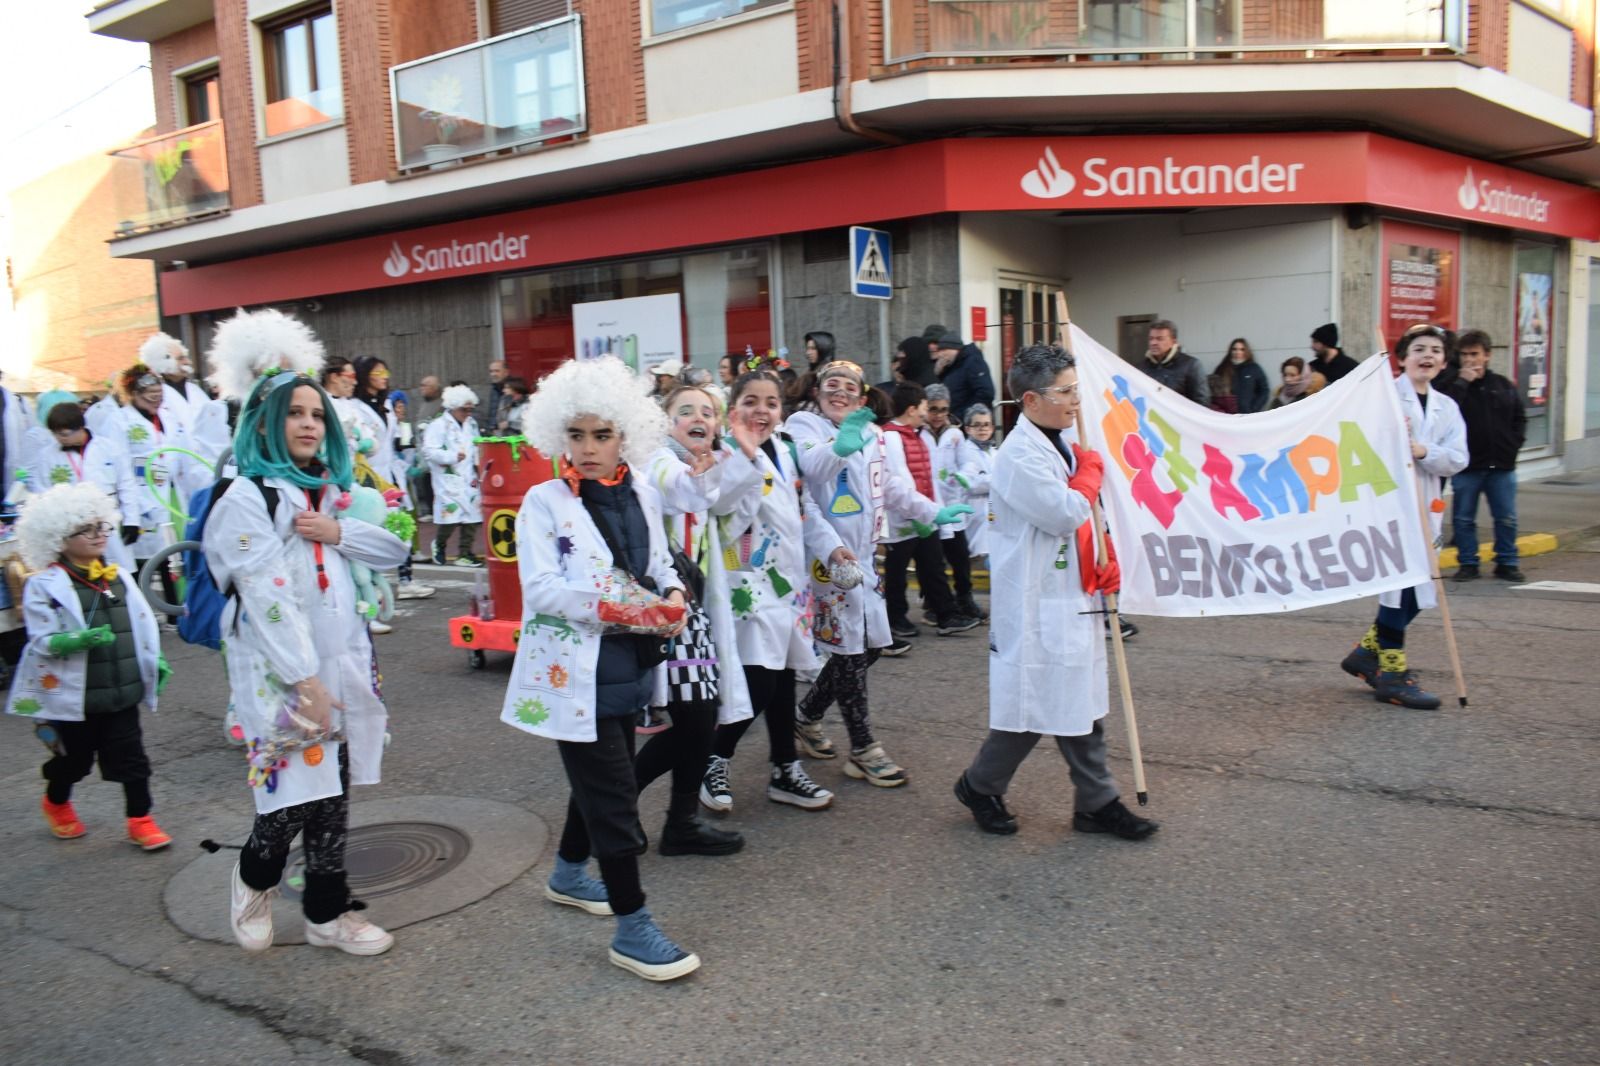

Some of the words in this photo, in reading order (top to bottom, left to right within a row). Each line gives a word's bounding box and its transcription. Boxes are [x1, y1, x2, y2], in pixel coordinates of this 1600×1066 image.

[1083, 155, 1304, 197] Santander
[1479, 180, 1550, 222] Santander
[412, 232, 530, 274] Santander
[1202, 421, 1398, 521] AMPA
